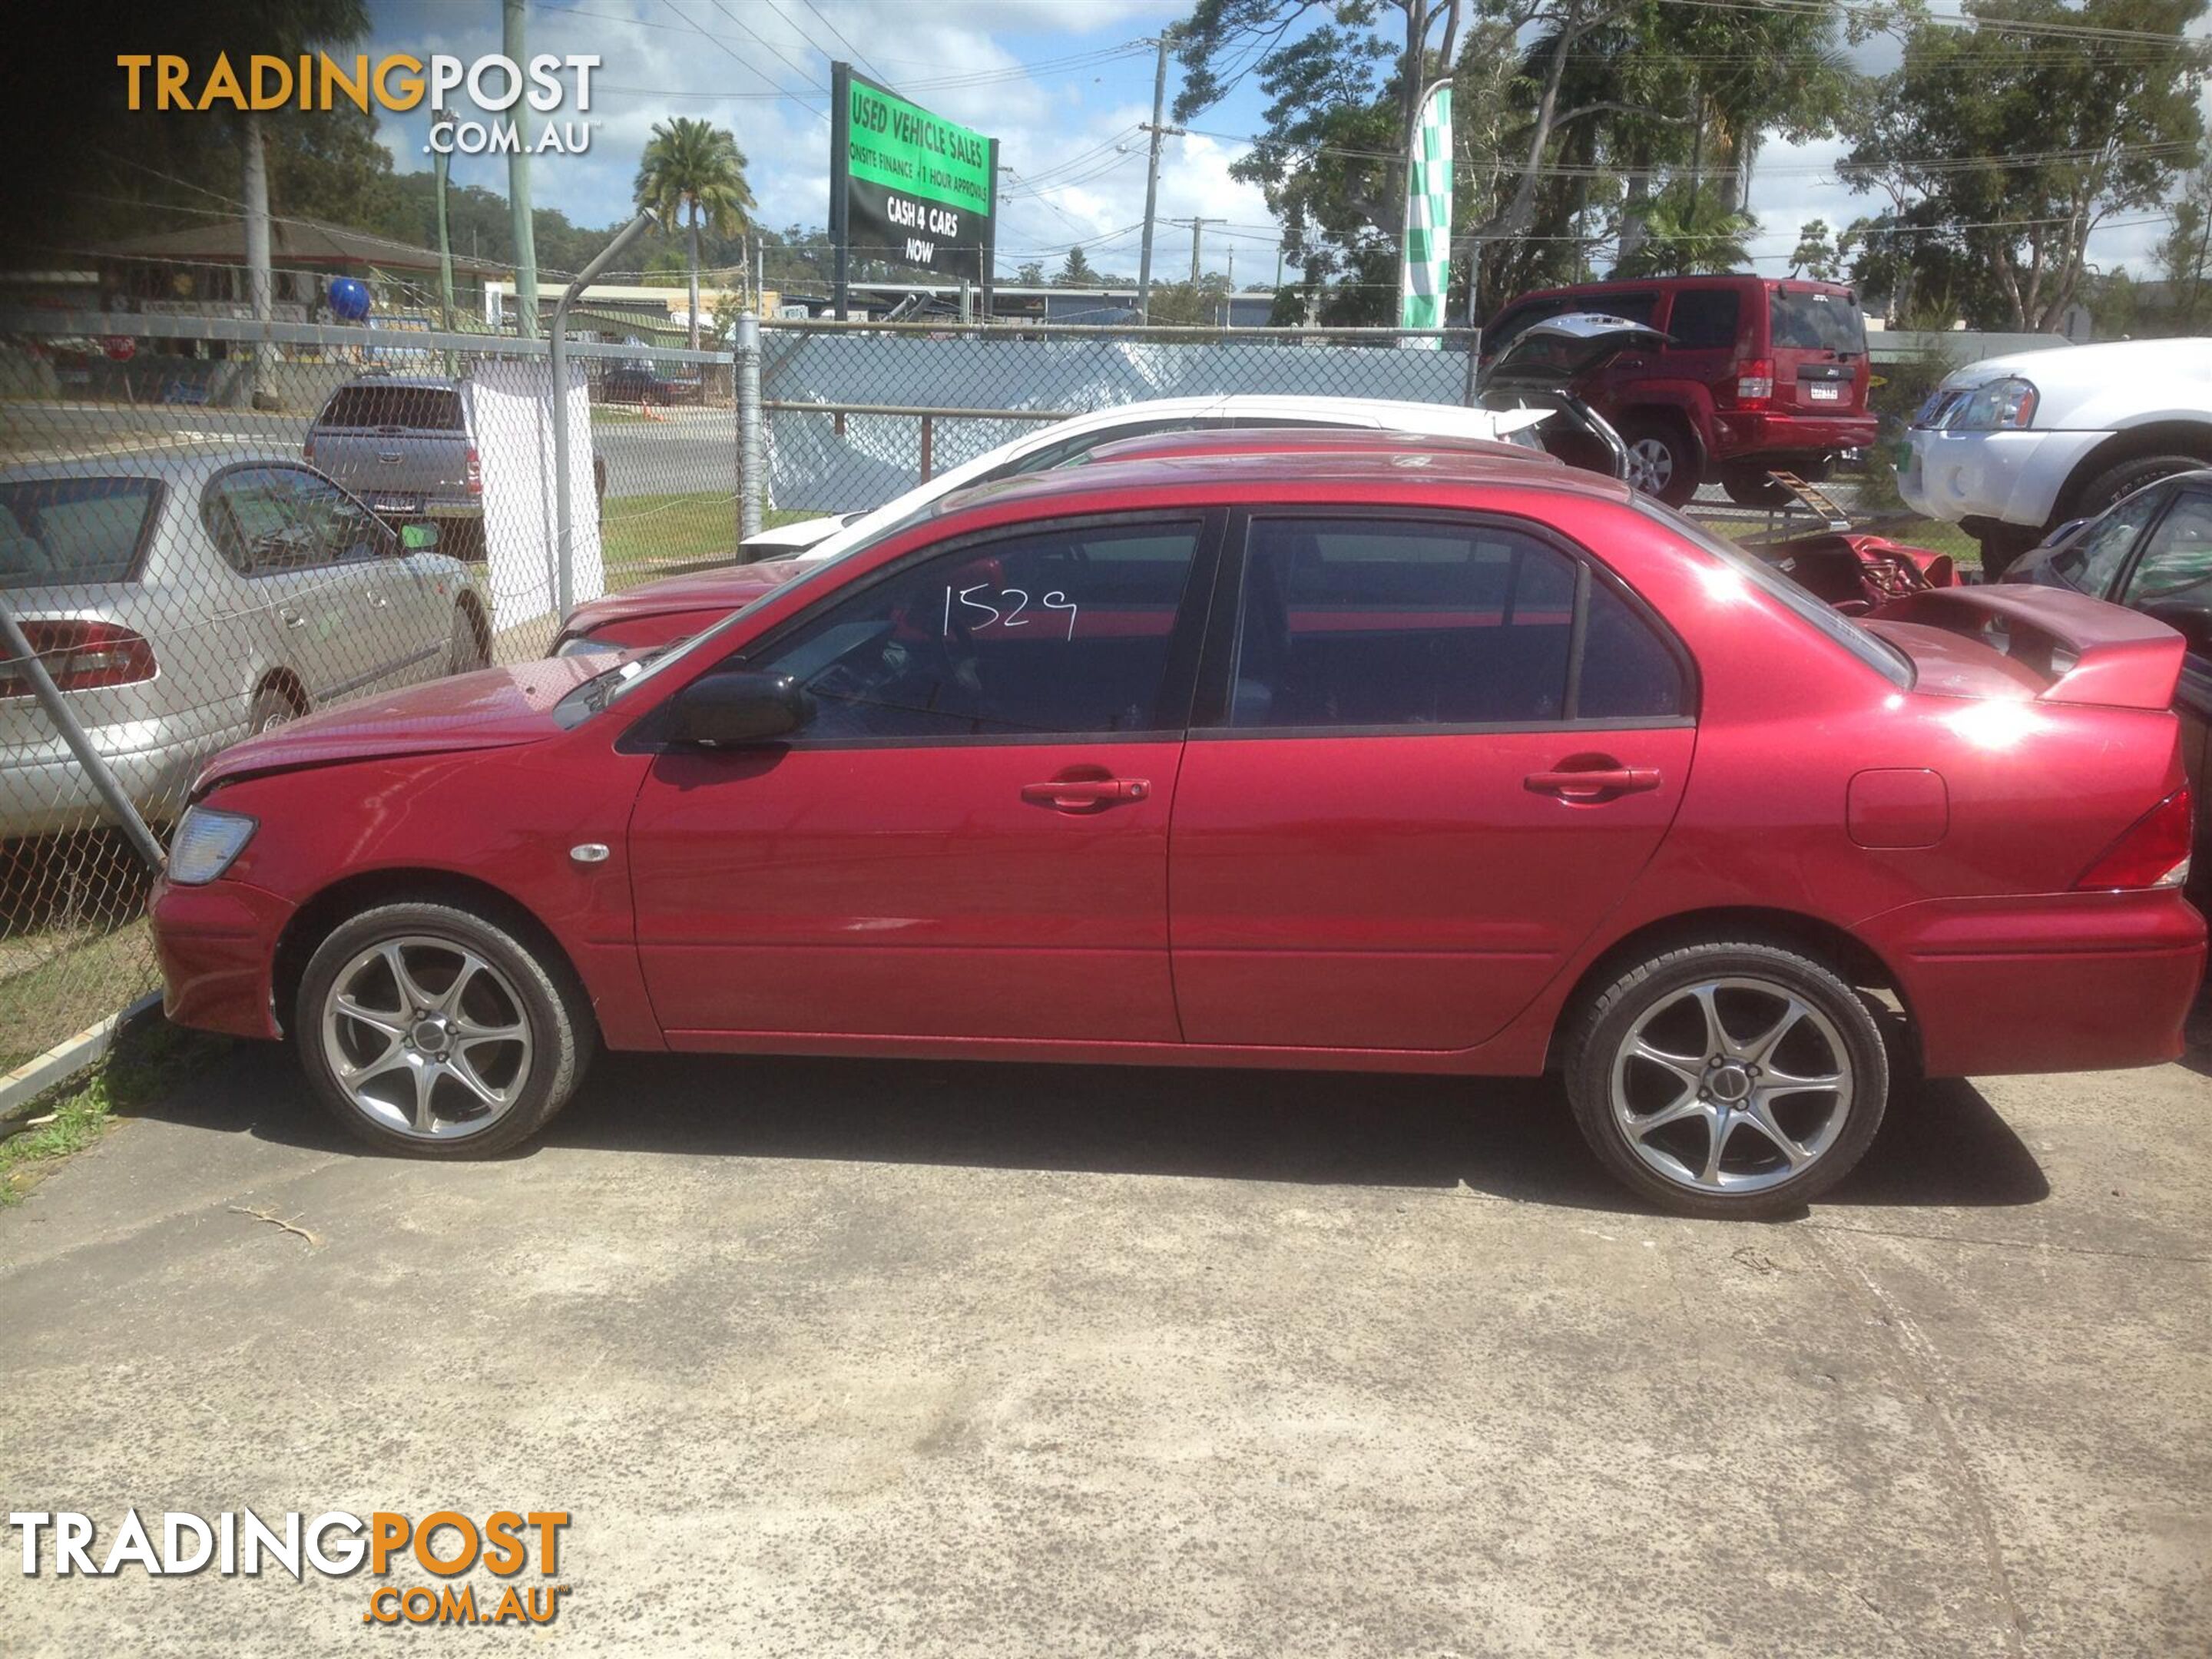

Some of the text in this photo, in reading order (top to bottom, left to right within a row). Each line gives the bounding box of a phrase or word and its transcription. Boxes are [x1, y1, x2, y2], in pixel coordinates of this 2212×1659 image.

[853, 91, 983, 169] USED VEHICLE SALES
[849, 141, 877, 167] ONSITE
[879, 152, 913, 179] FINANCE
[930, 168, 952, 192] HOUR
[952, 176, 988, 202] APPROVALS
[887, 196, 959, 238] CASH 4 CARS
[905, 237, 935, 263] NOW
[943, 582, 1078, 642] 1529
